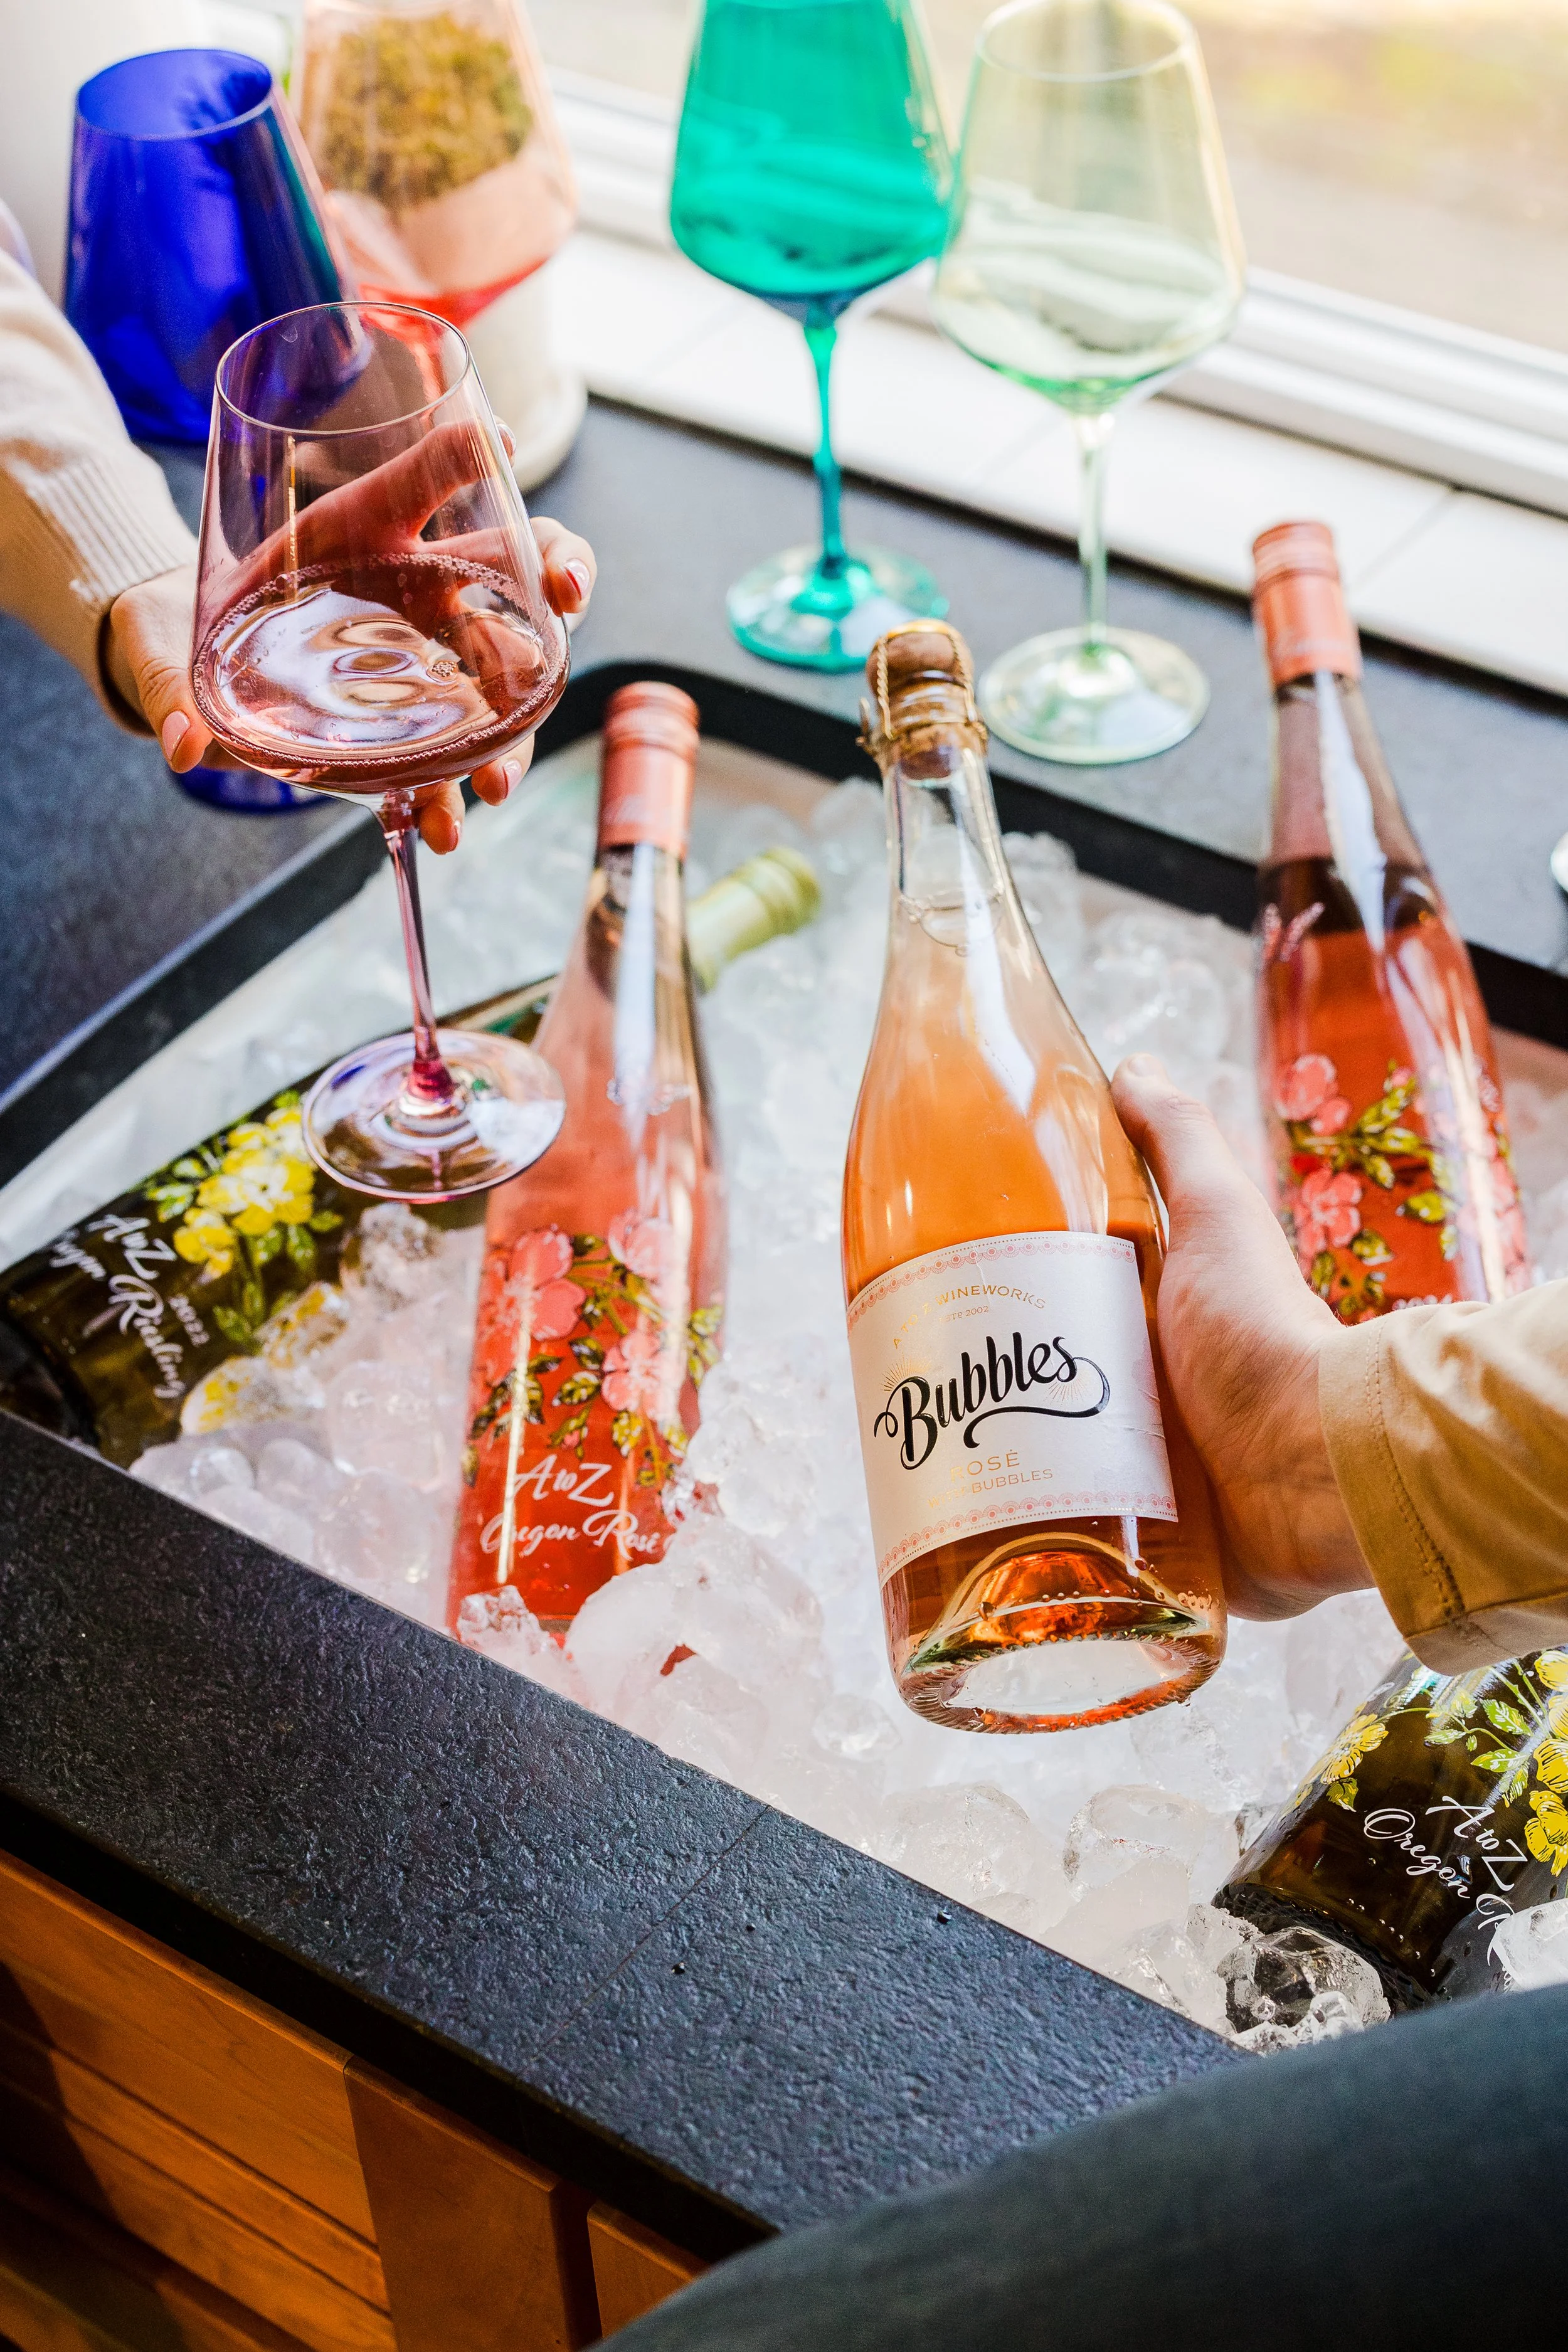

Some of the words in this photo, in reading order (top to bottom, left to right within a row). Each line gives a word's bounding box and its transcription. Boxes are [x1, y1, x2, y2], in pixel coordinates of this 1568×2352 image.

[935, 1285, 1046, 1310] WINEWORKS
[965, 1305, 989, 1316] 2002
[874, 1332, 1110, 1470] Bubbles
[972, 1469, 1053, 1493] BUBBLES
[1364, 1808, 1471, 1899] Oregon
